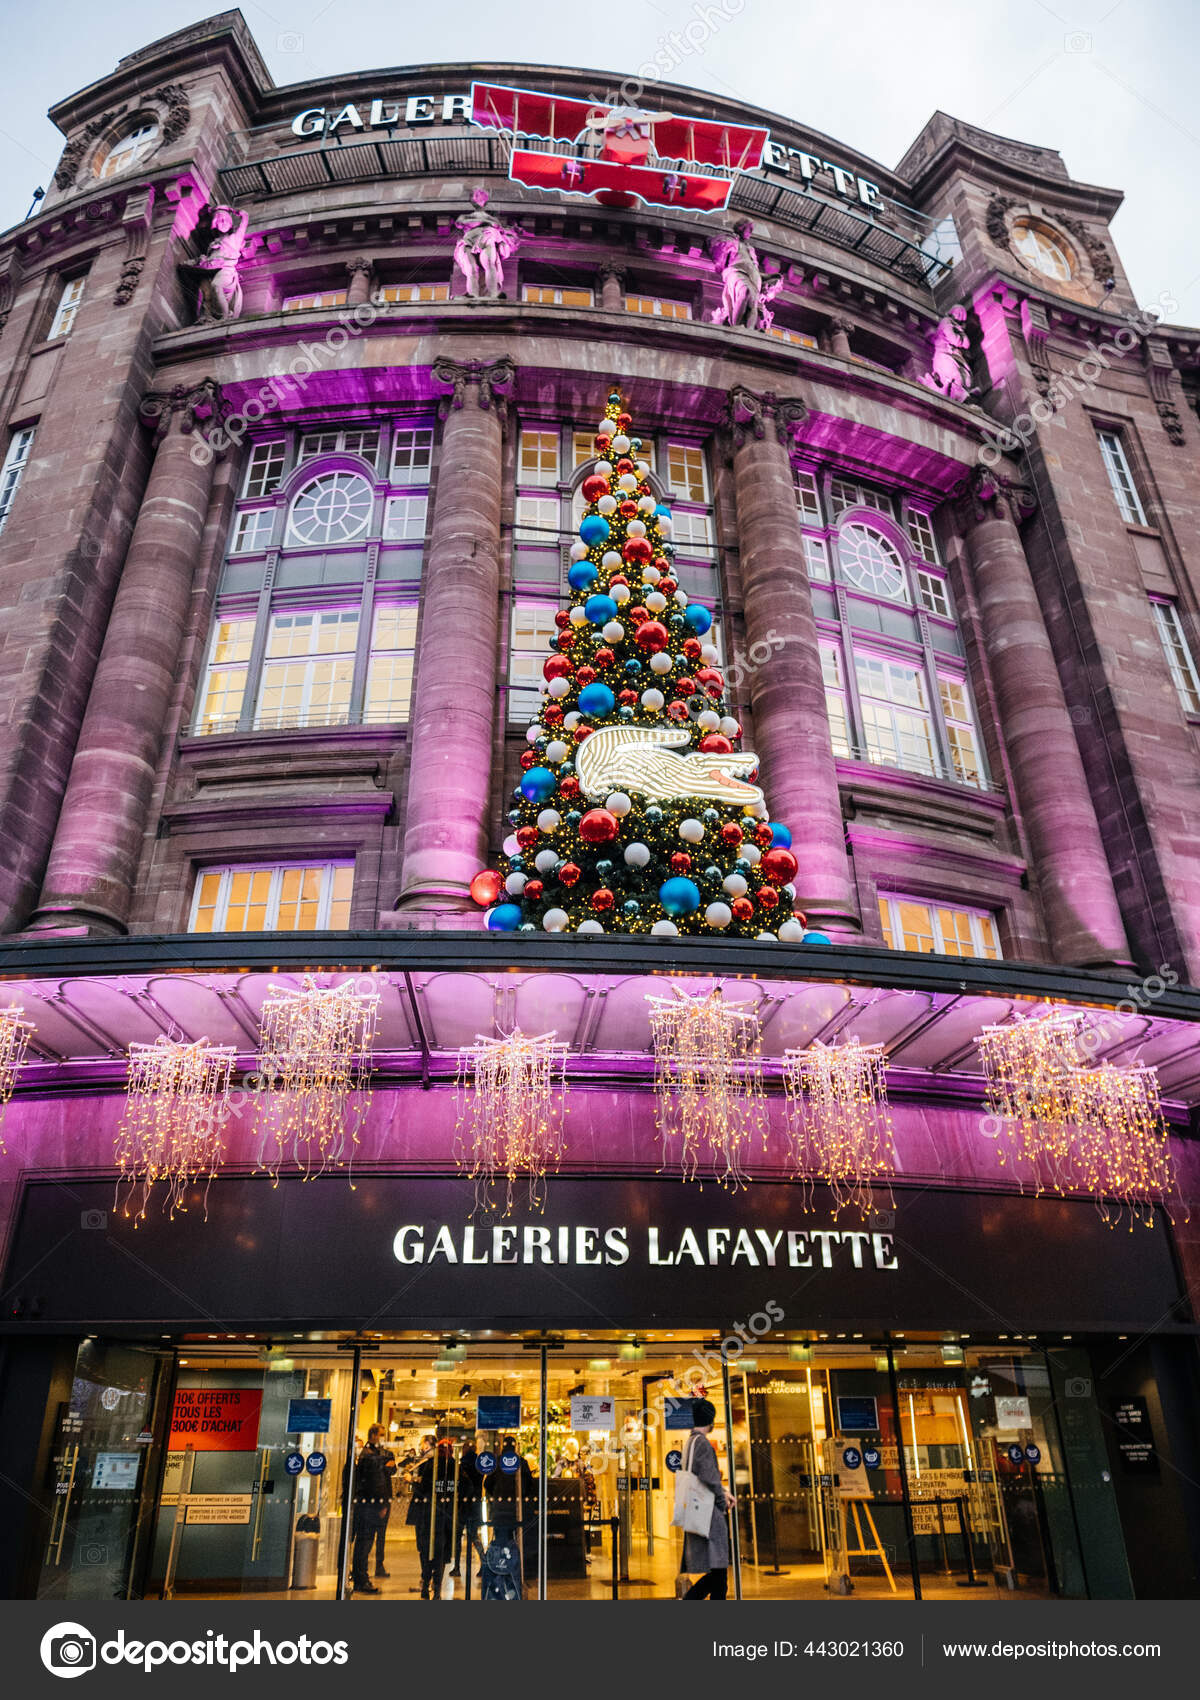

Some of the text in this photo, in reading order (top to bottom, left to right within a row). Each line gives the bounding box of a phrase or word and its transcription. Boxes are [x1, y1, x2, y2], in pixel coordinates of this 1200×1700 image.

[291, 95, 885, 211] GALER ETTE
[392, 1225, 899, 1270] GALERIES LAFAYETTE
[773, 1386, 807, 1394] JACOBS
[177, 1392, 241, 1404] 10€ OFFERTS
[175, 1406, 222, 1418] TOUS LES
[171, 1419, 243, 1432] 300€ D'ACHAT
